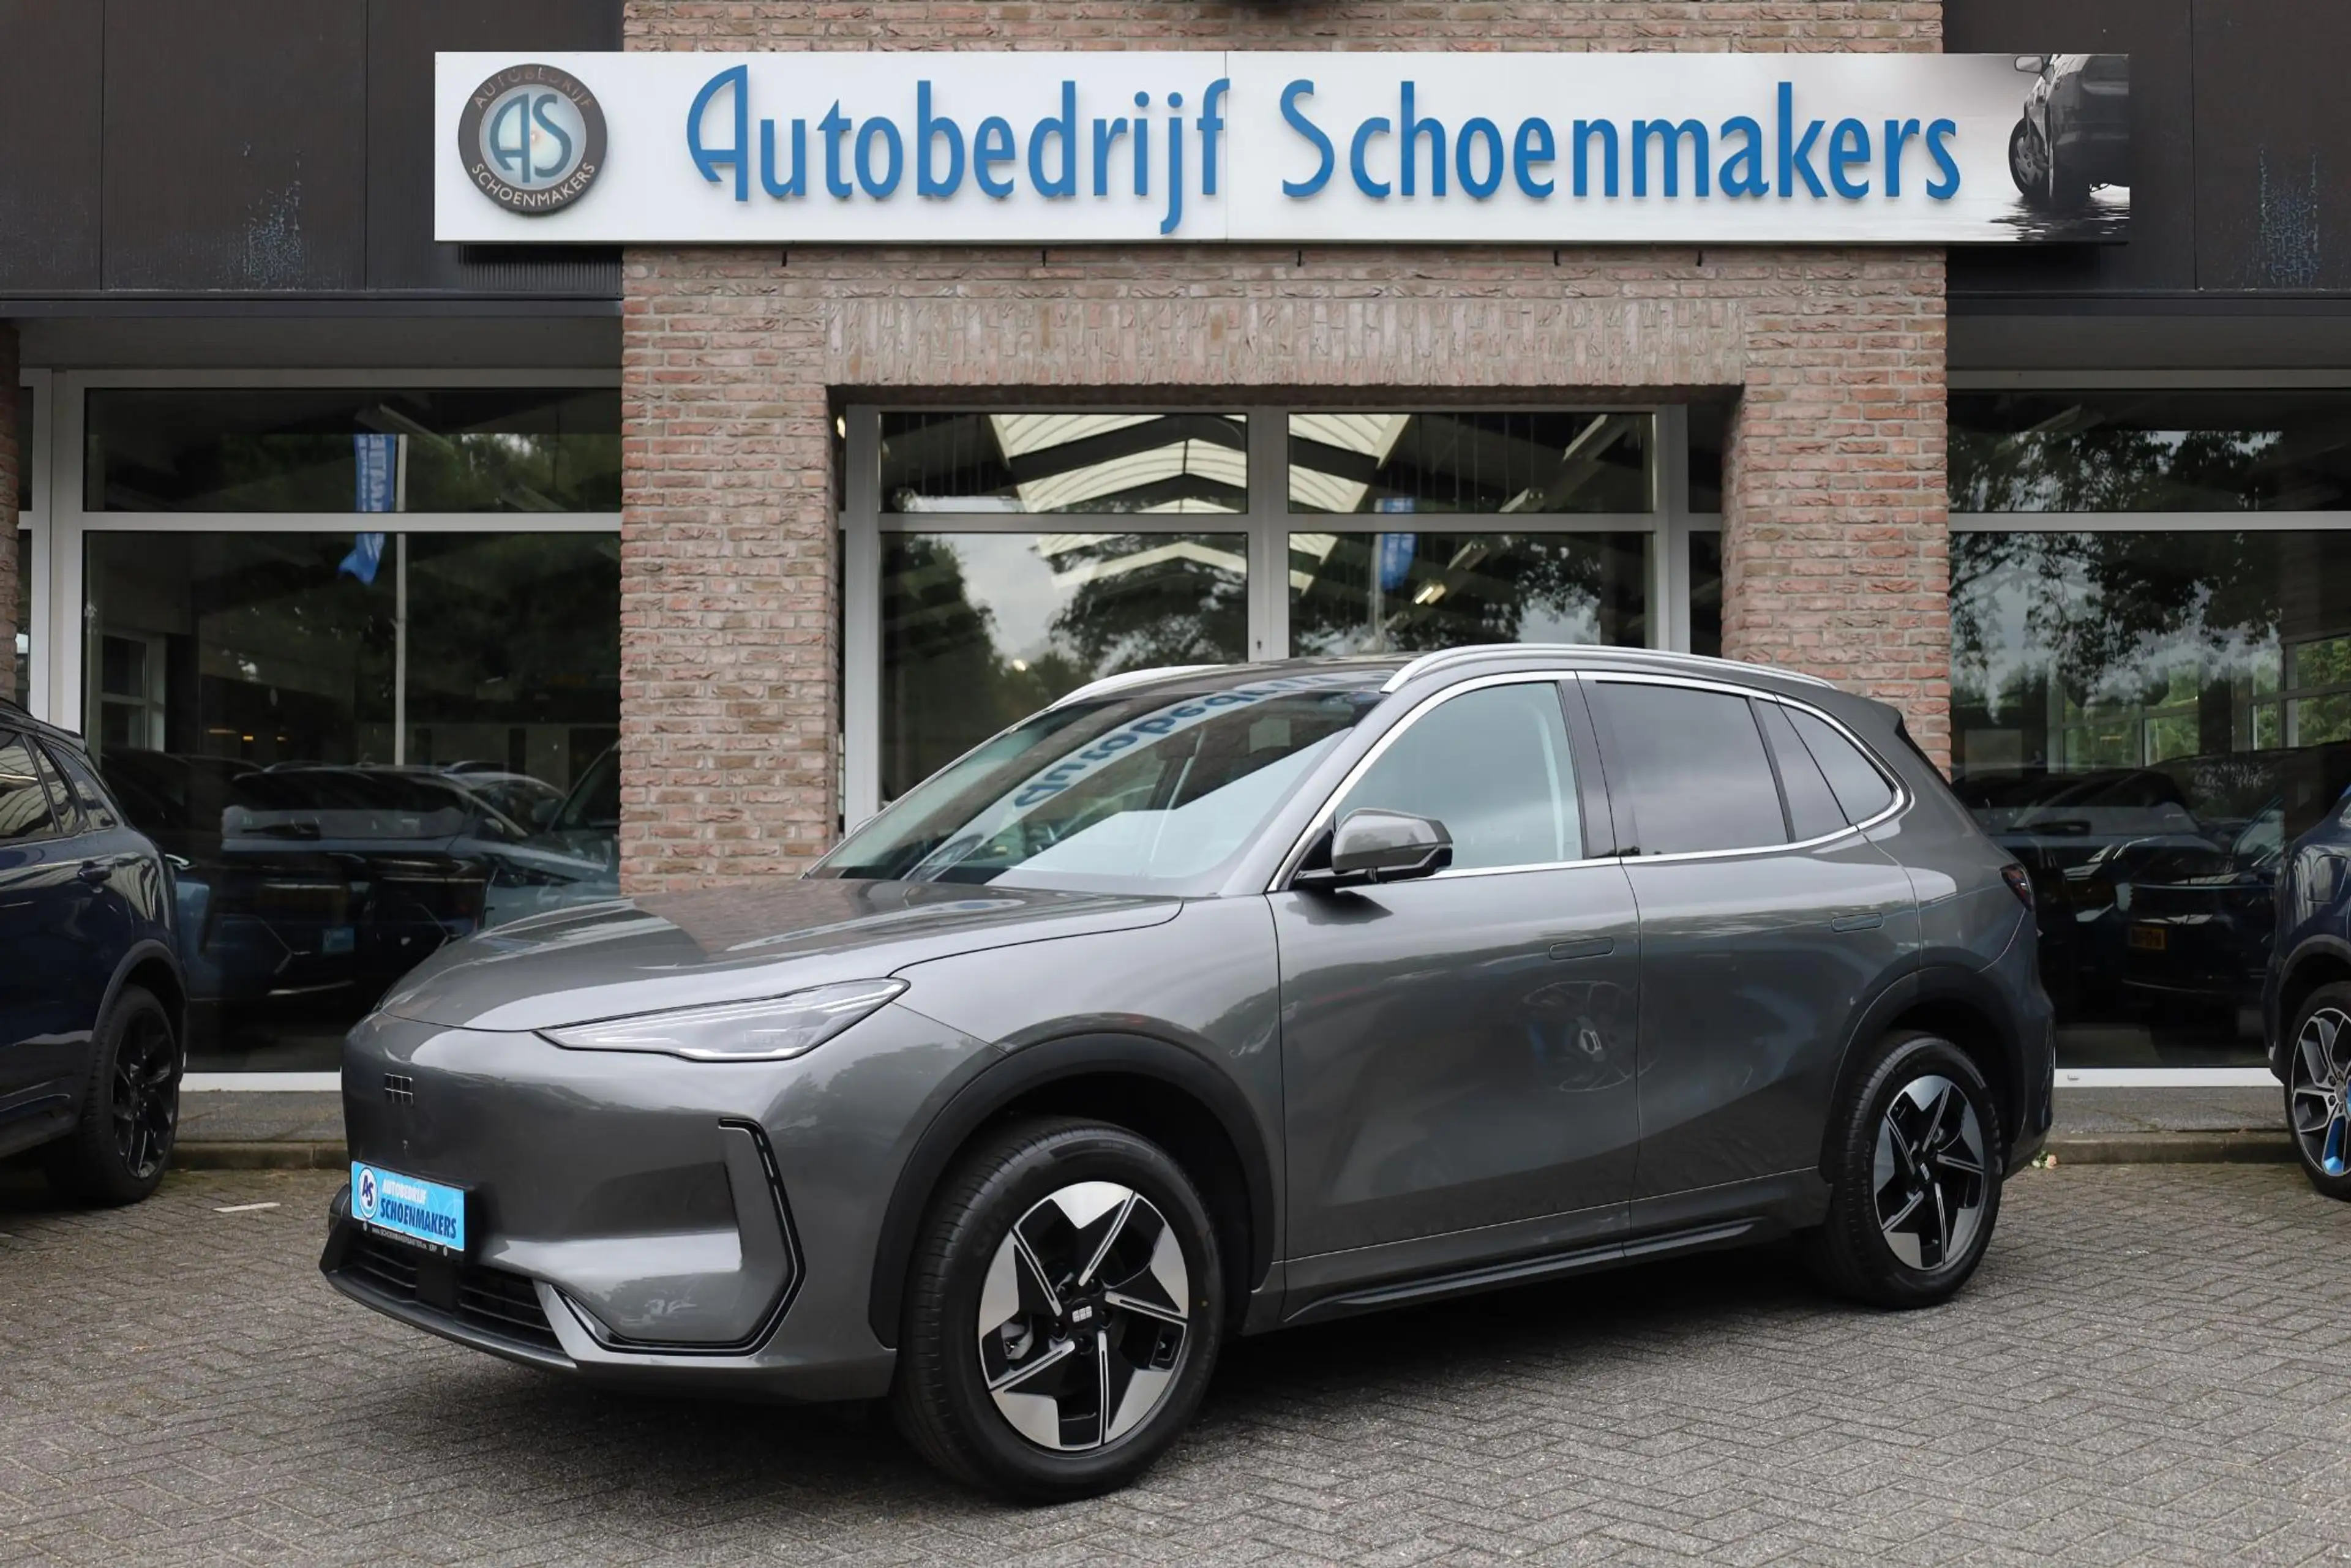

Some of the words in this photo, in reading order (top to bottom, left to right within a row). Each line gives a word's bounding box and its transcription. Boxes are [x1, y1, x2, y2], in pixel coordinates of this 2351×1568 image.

[474, 66, 594, 109] AUTOBEDRIJF
[490, 93, 572, 184] AS
[686, 64, 1231, 235] Autobedrijf
[1280, 80, 1961, 200] Schoenmakers
[472, 162, 596, 208] SCHOENMAKERS
[362, 1174, 374, 1207] AS
[380, 1198, 457, 1240] SCHOENMAKERS
